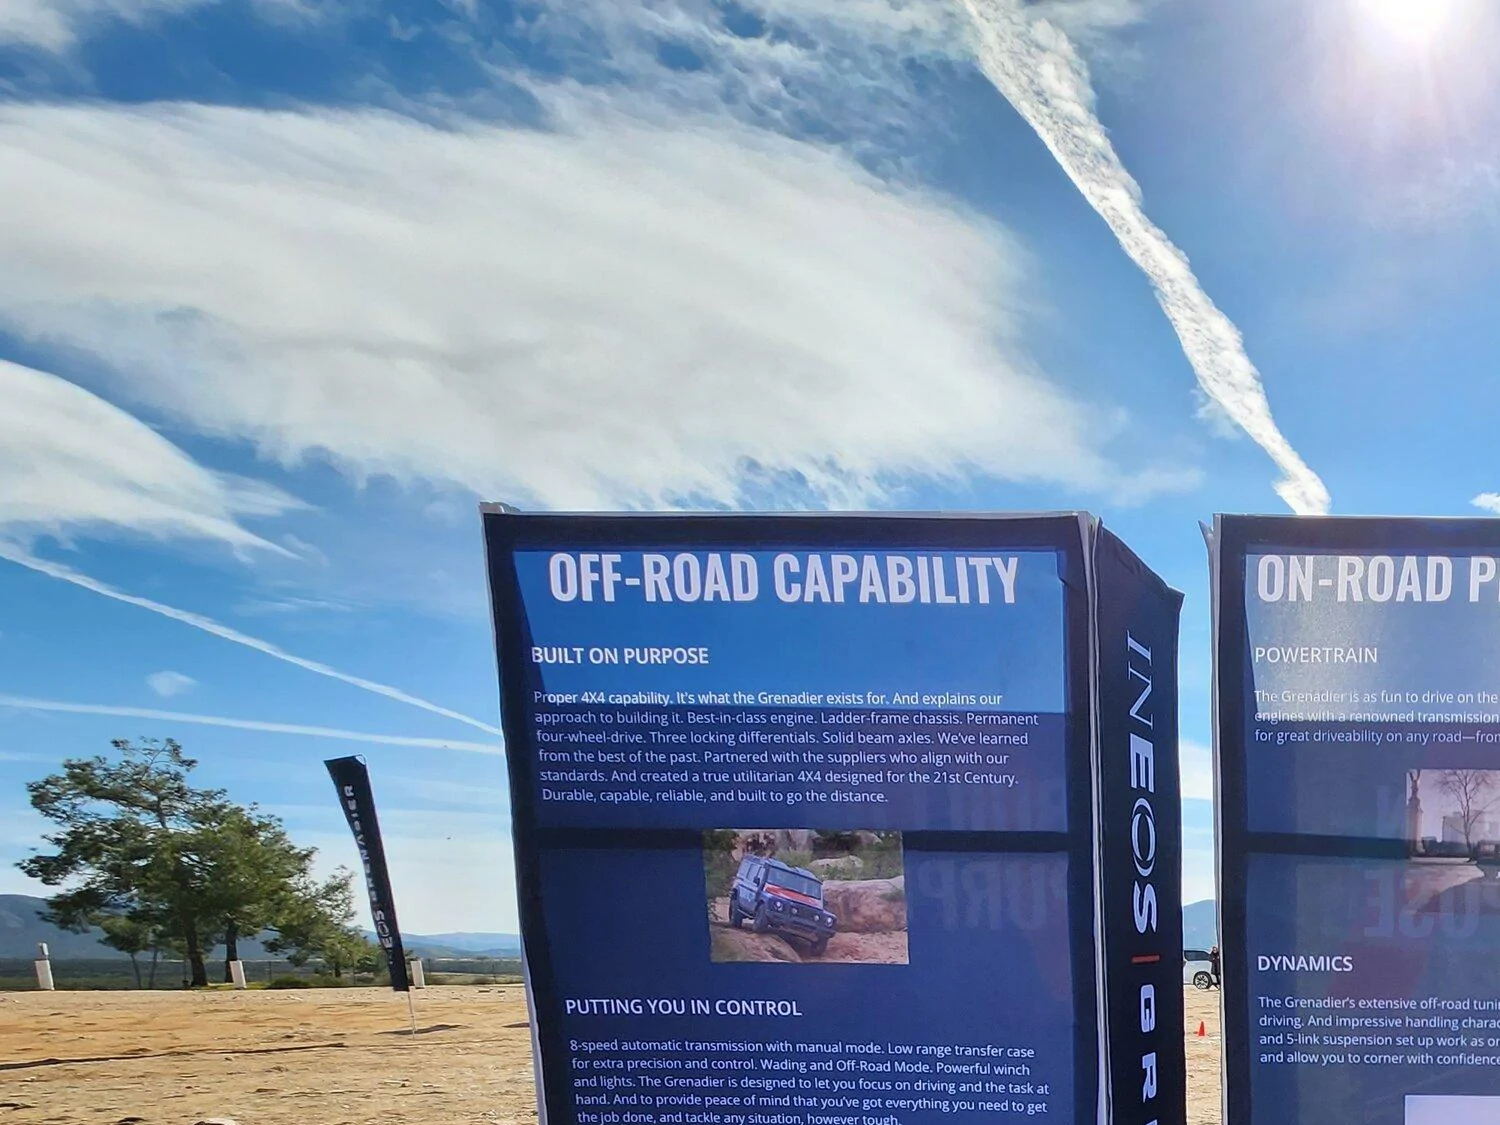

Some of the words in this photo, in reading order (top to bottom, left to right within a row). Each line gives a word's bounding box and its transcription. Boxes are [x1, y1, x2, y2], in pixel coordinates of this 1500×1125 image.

[549, 552, 758, 602] OFF-ROAD
[773, 553, 1018, 603] CAPABILITY
[1257, 554, 1452, 603] ON-ROAD
[531, 646, 584, 663] BUILT
[589, 647, 618, 664] ON
[623, 647, 709, 664] PURPOSE
[1254, 646, 1378, 663] POWERTRAIN
[534, 710, 596, 725] approach
[599, 712, 613, 723] to
[616, 711, 669, 726] building
[671, 712, 683, 723] it.
[687, 711, 767, 723] Best-in-class
[770, 713, 817, 727] engine.
[820, 711, 909, 724] Ladder-frame
[912, 711, 962, 724] chassis.
[966, 712, 1038, 725] Permanent
[1254, 728, 1273, 741] for
[1276, 730, 1310, 745] great
[1312, 728, 1383, 745] driveability
[1385, 732, 1402, 742] on
[1405, 732, 1429, 745] any
[1126, 629, 1158, 934] INEOS
[1257, 955, 1352, 971] DYNAMICS
[565, 998, 642, 1014] PUTTING
[646, 999, 685, 1014] YOU
[690, 999, 710, 1014] IN
[715, 999, 802, 1015] CONTROL
[1259, 1014, 1304, 1029] driving.
[1307, 1014, 1332, 1026] And
[1335, 1015, 1402, 1029] impressive
[1405, 1015, 1459, 1031] handling
[569, 1038, 618, 1054] 8-speed
[621, 1039, 682, 1051] automatic
[684, 1040, 763, 1051] transmission
[765, 1040, 793, 1052] with
[795, 1040, 842, 1053] manual
[845, 1041, 885, 1054] mode.
[887, 1042, 913, 1054] Low
[916, 1045, 952, 1058] range
[954, 1043, 1004, 1056] transfer
[1006, 1048, 1034, 1057] case
